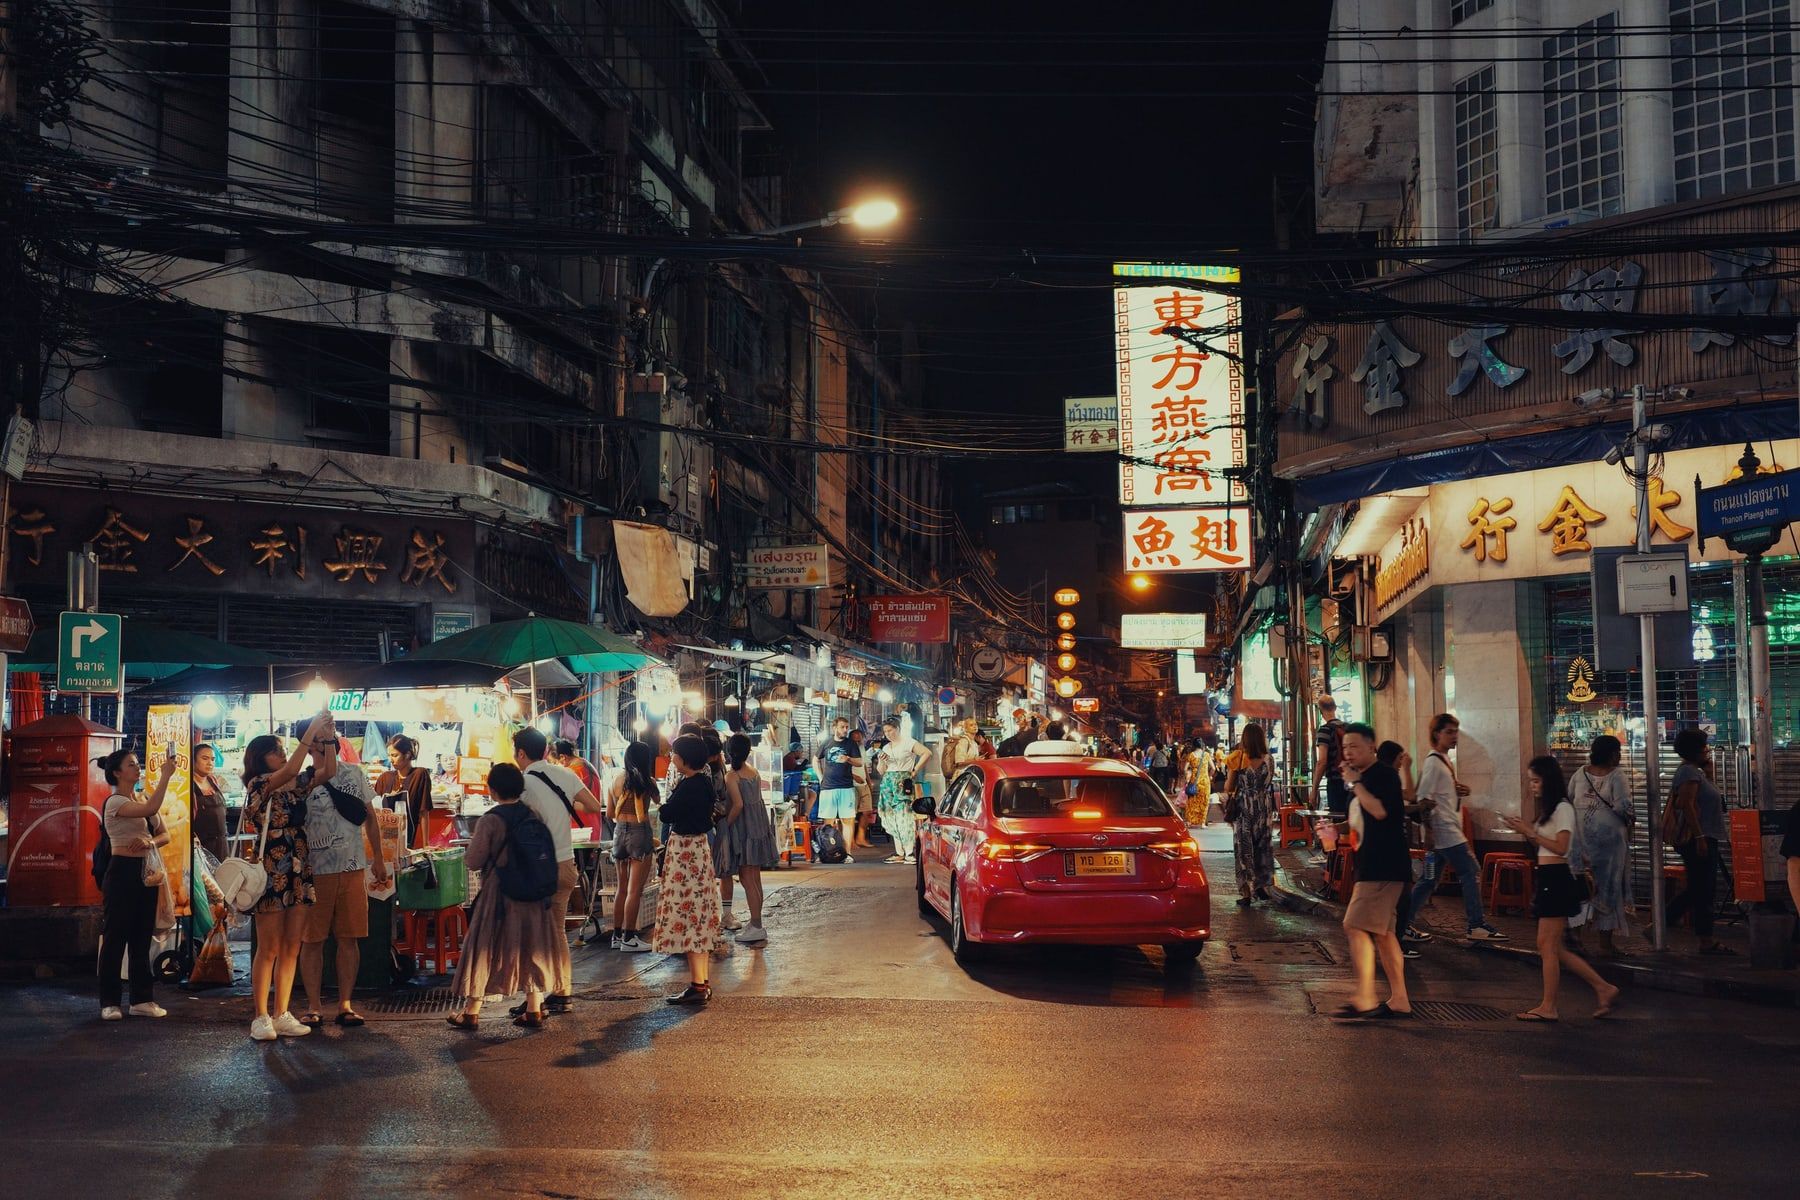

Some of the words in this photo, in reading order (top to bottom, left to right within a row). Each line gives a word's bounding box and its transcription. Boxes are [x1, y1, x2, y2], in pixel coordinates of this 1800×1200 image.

[1149, 291, 1212, 496] 東方燕窩
[1713, 484, 1789, 513] ถนนแปลงนาม
[1721, 515, 1743, 525] Thanon
[1743, 510, 1764, 520] Plaeng
[1765, 507, 1779, 516] Nam
[1131, 516, 1243, 567] 魚翅
[75, 661, 105, 672] ตลาด
[1103, 855, 1119, 865] 126
